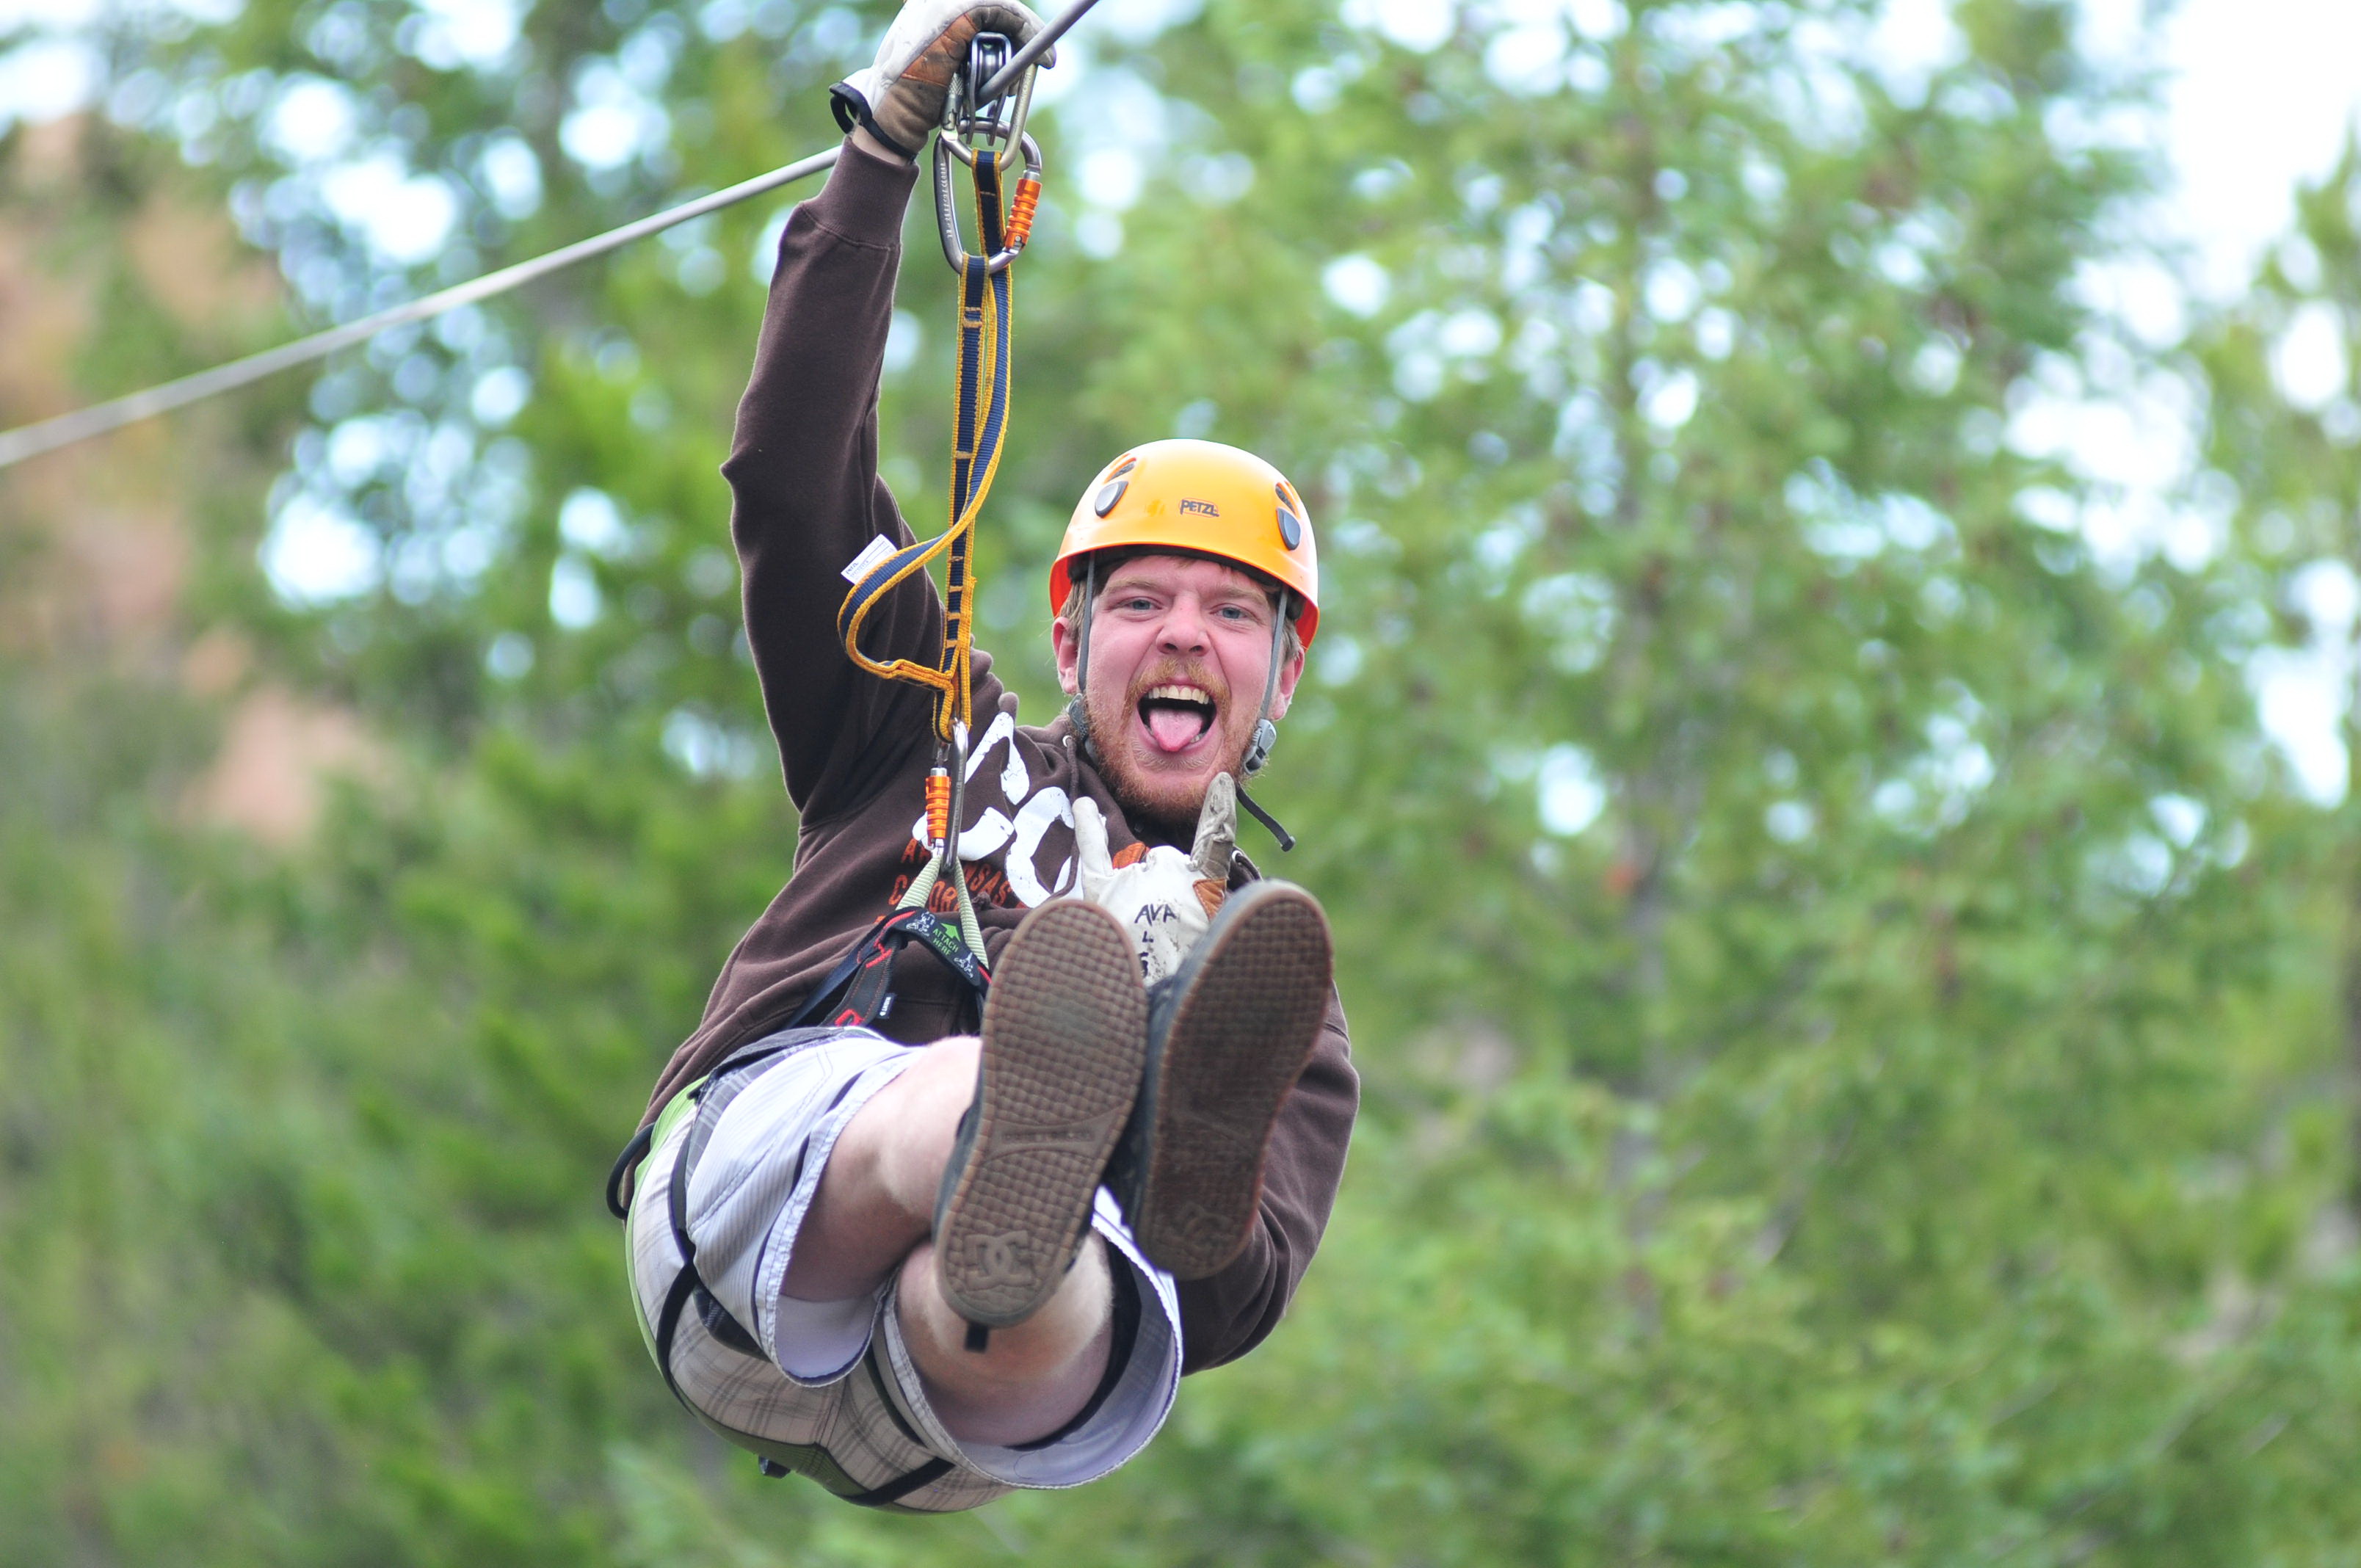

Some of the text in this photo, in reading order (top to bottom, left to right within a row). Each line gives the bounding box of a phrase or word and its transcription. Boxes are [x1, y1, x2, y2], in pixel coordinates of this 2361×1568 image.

[1180, 499, 1220, 517] PETZL
[902, 838, 1012, 909] ANSAS
[1134, 904, 1178, 926] AVA
[932, 929, 959, 953] ATTACH
[932, 938, 952, 956] HERE
